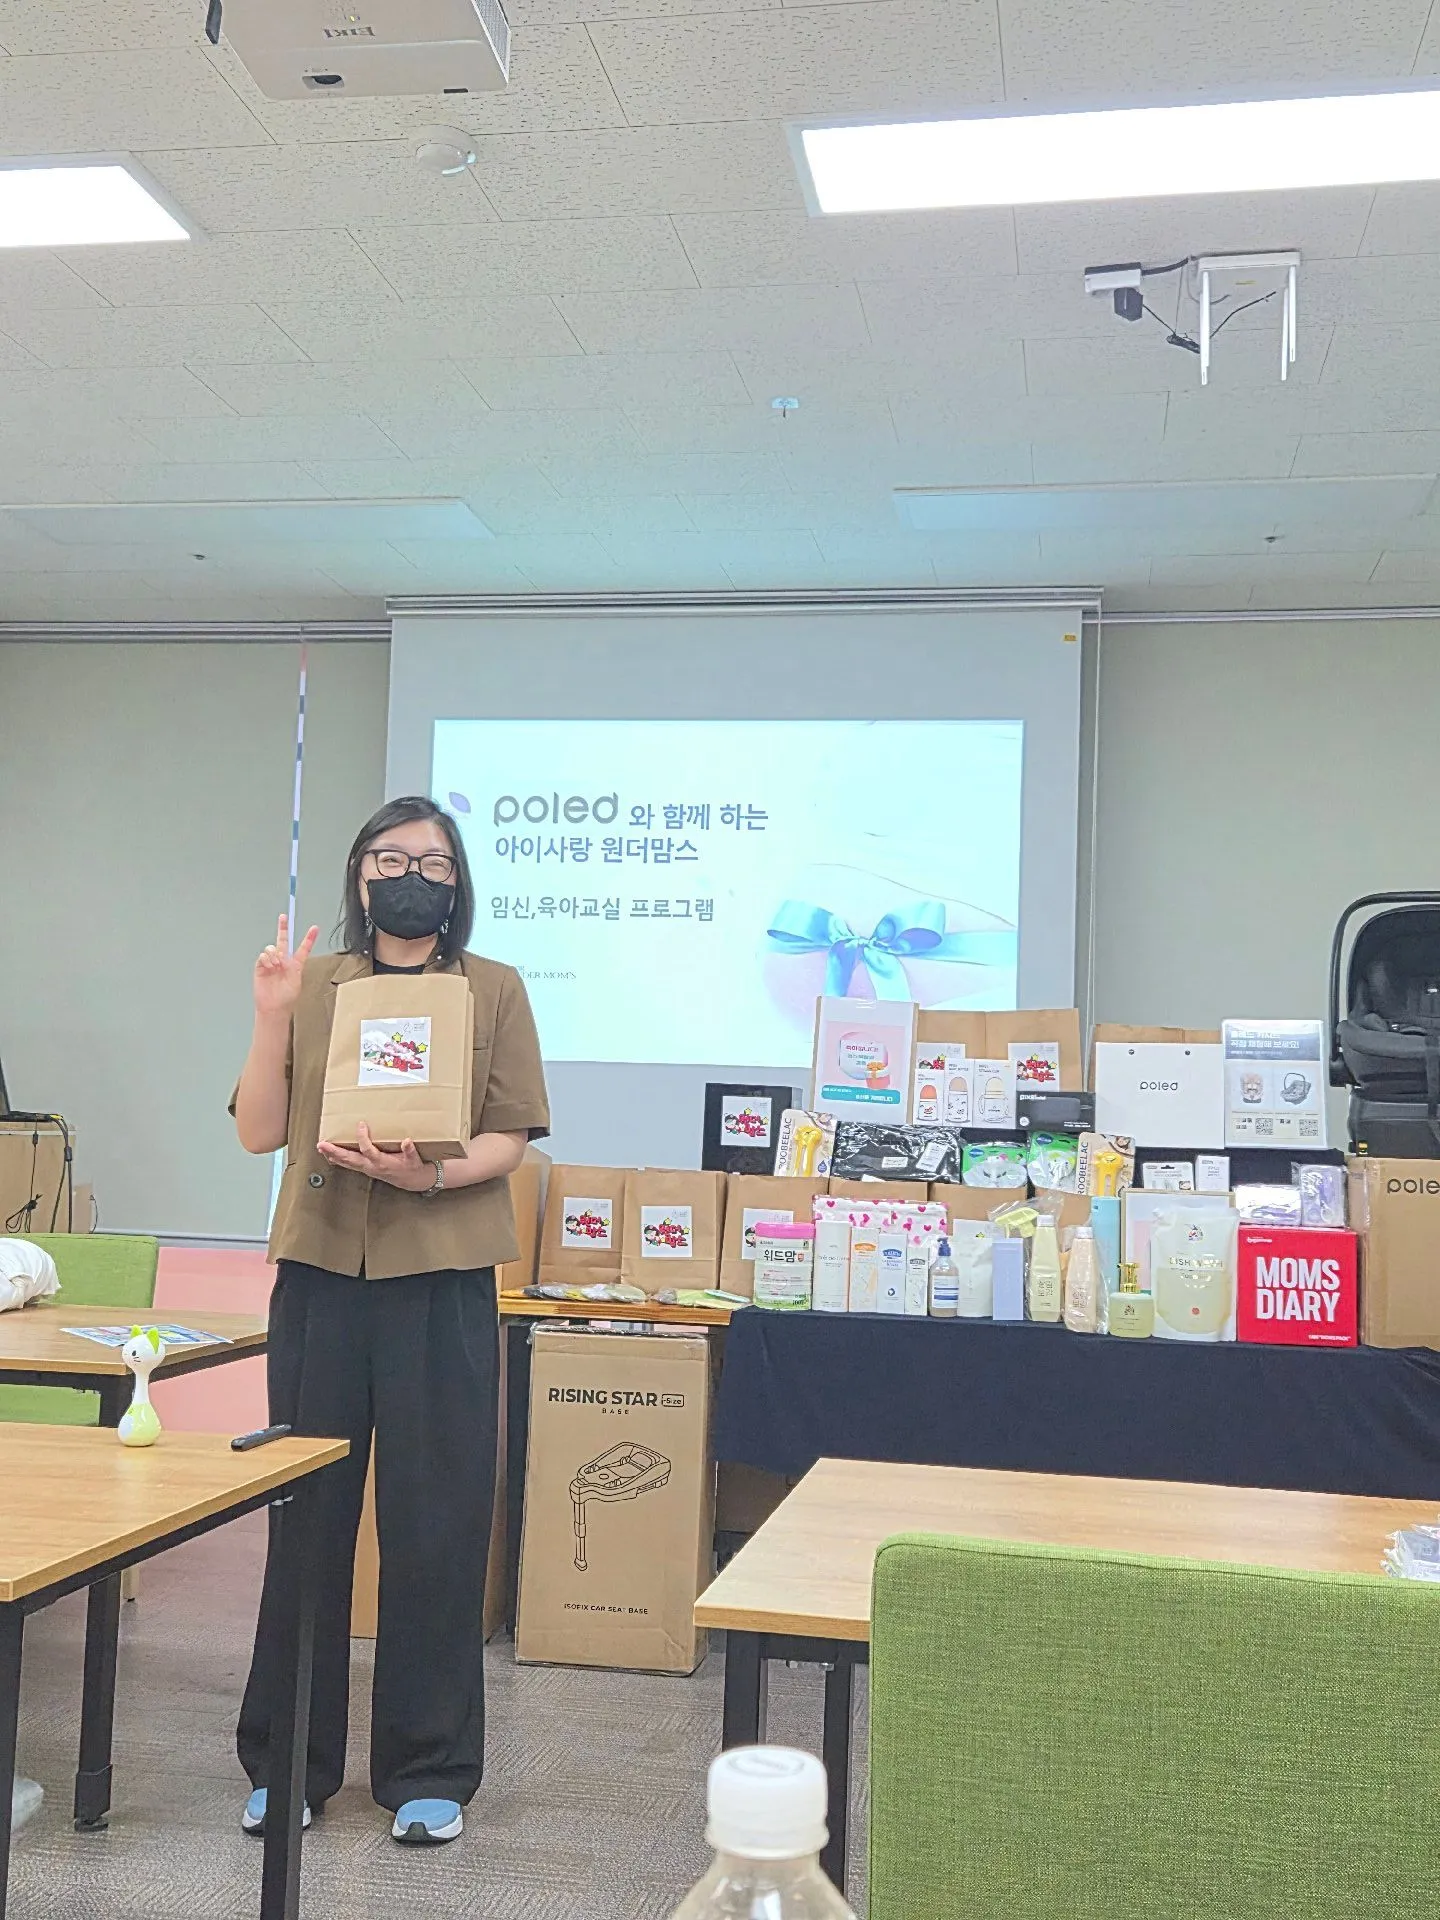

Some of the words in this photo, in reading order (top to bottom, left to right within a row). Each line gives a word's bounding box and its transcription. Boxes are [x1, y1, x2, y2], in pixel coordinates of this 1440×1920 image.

[322, 26, 376, 38] EIKI
[493, 791, 619, 827] poled
[628, 803, 655, 830] 와
[662, 803, 710, 830] 함께
[719, 803, 769, 831] 하는
[495, 835, 593, 863] 아이사랑
[600, 836, 699, 864] 원더맘스
[490, 895, 621, 921] 임신,육아교실
[629, 897, 714, 922] 프로그램
[1139, 1081, 1178, 1091] poled
[1387, 1177, 1440, 1194] pole
[763, 1249, 797, 1263] 위드맘
[1256, 1256, 1340, 1291] MOMS
[1256, 1288, 1340, 1322] DIARY
[548, 1387, 608, 1404] RISING
[611, 1390, 658, 1406] STAR
[601, 1407, 629, 1415] BASE
[563, 1603, 589, 1611] ISOFIX
[628, 1607, 648, 1615] BASE
